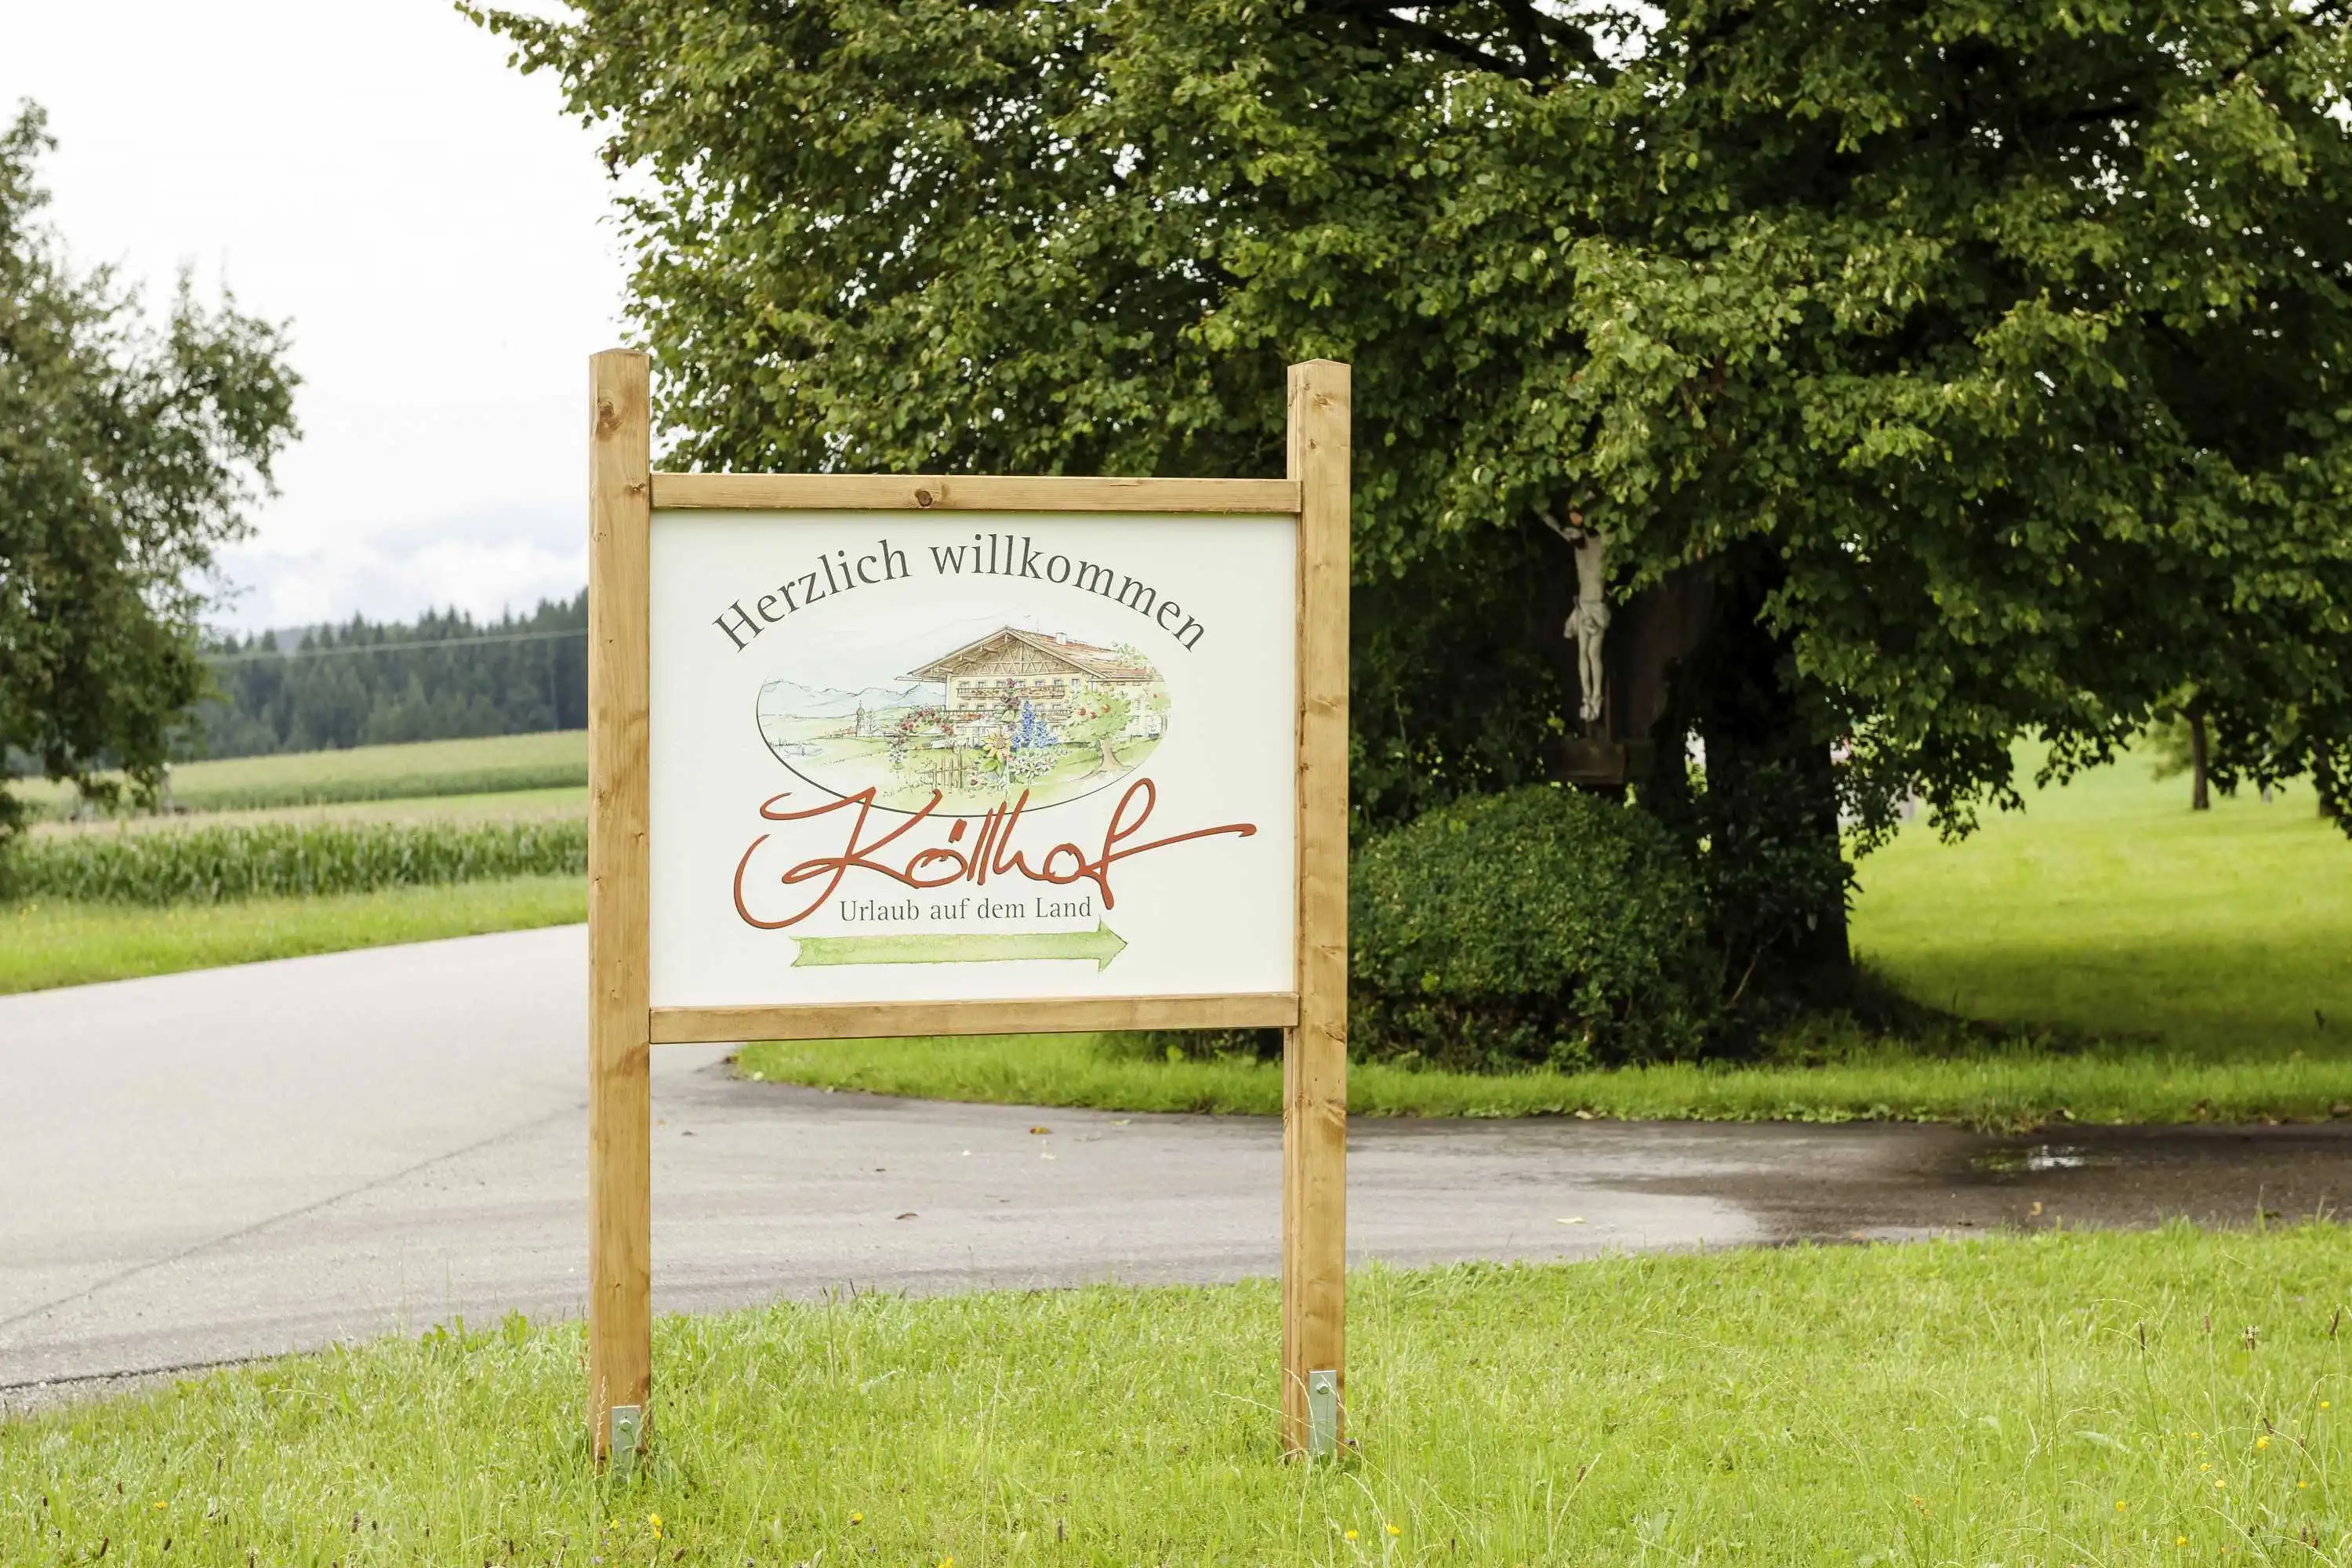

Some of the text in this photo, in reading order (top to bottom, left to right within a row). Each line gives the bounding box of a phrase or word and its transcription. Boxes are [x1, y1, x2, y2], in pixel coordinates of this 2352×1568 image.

[712, 533, 1207, 652] Herzlich willkommen
[840, 896, 1092, 922] Urlaub auf dem Land
